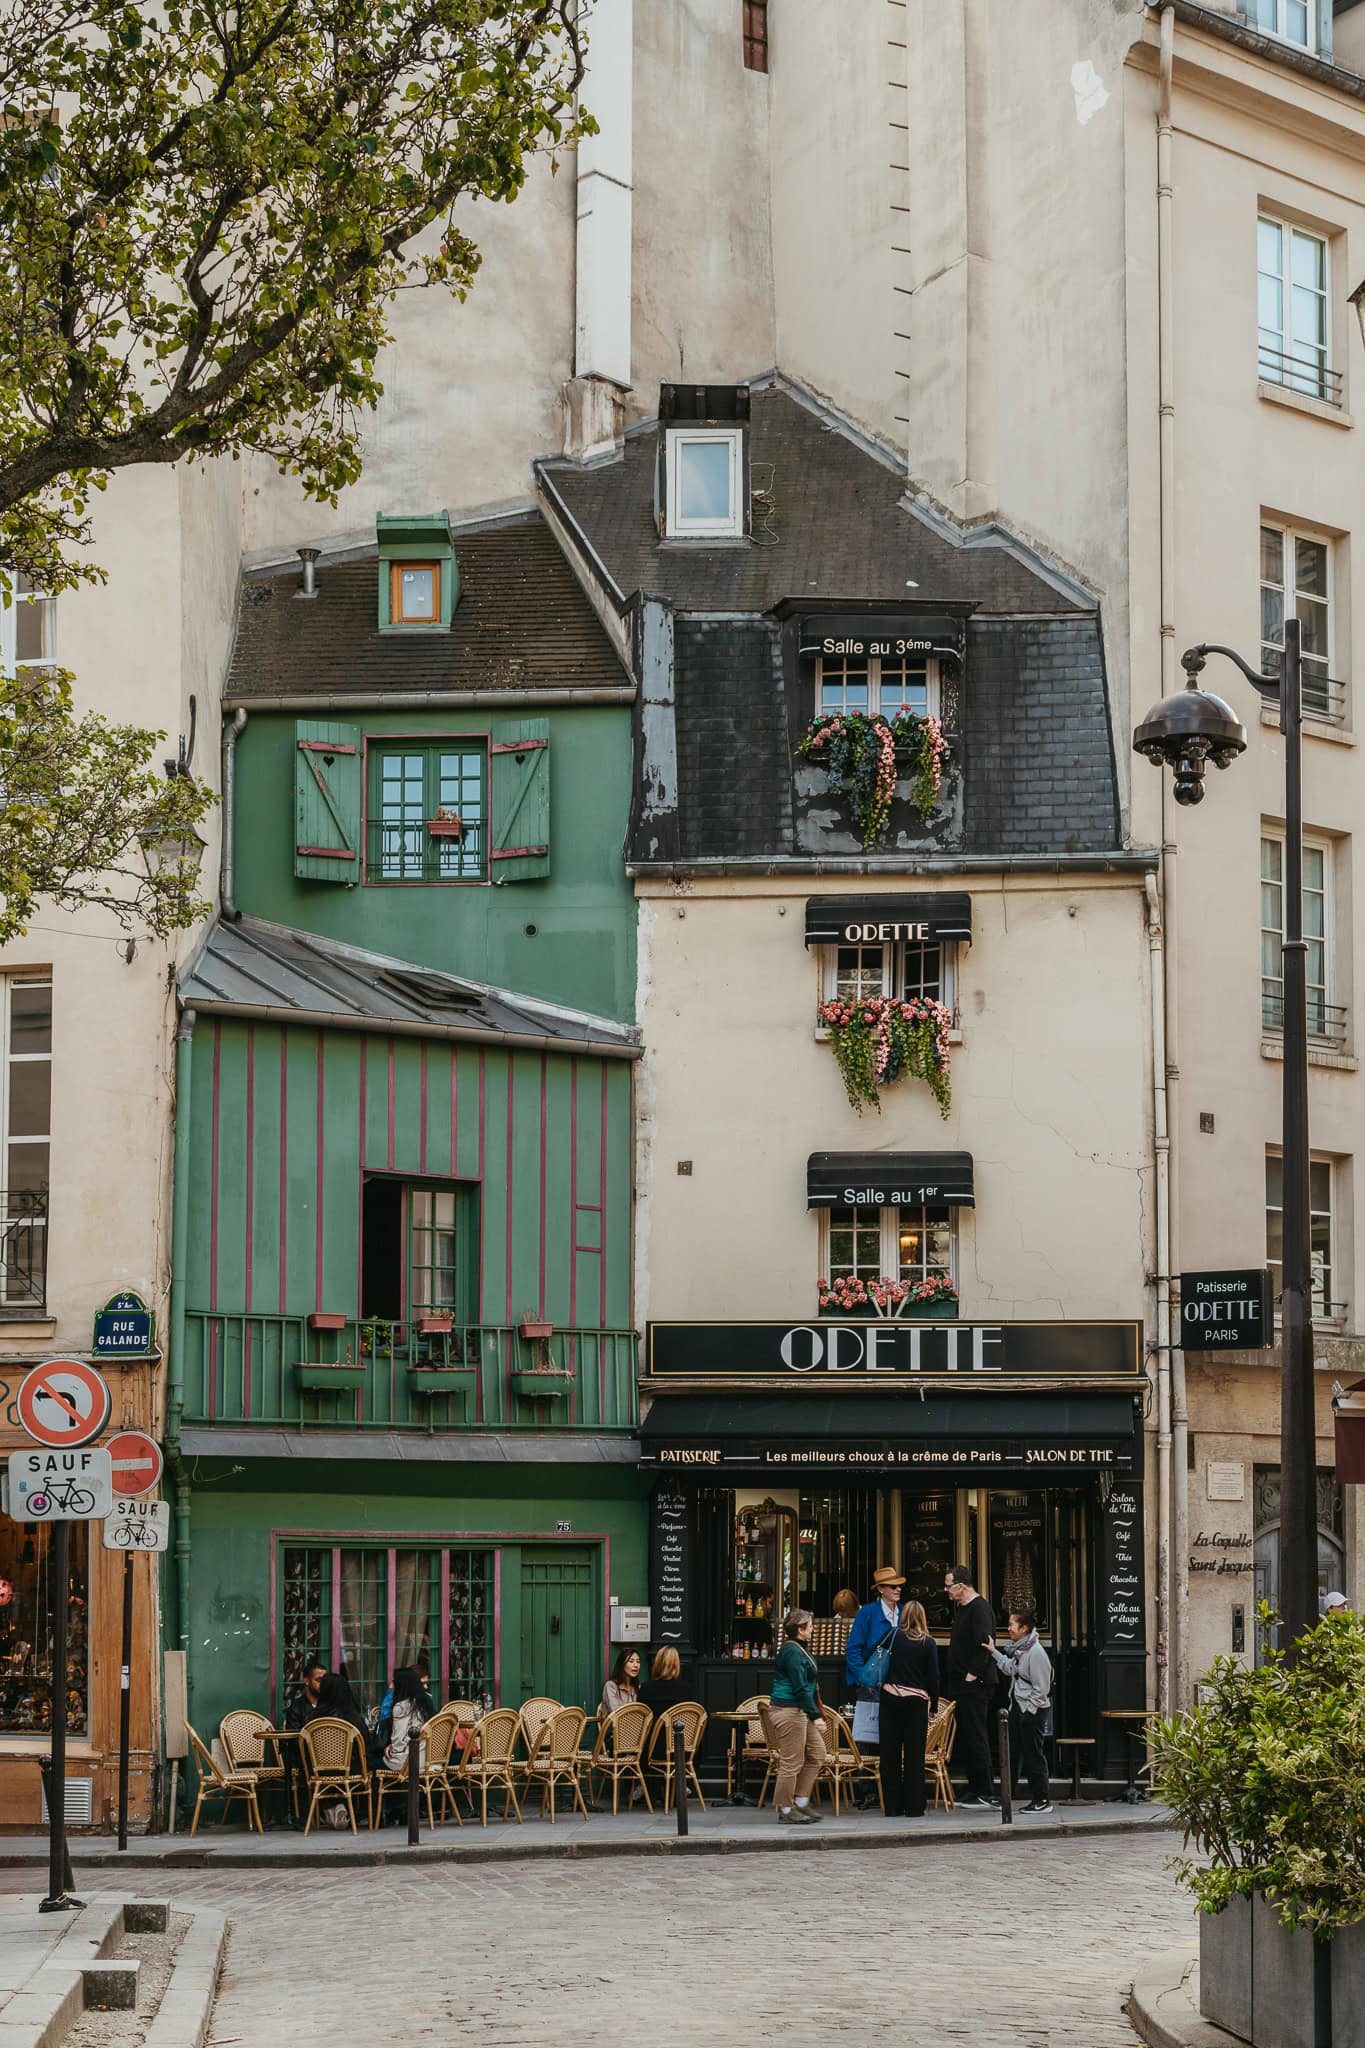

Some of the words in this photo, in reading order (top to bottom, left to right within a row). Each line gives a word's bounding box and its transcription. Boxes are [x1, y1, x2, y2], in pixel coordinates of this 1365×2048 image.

[823, 638, 864, 654] Salle
[870, 642, 890, 655] au
[845, 923, 929, 942] ODETTE
[843, 1188, 885, 1204] Salle
[891, 1191, 911, 1203] au
[917, 1187, 938, 1203] 1er
[1196, 1280, 1247, 1293] Patisserie
[1184, 1300, 1260, 1322] ODETTE
[112, 1321, 136, 1332] RUE
[98, 1335, 148, 1345] GALANDE
[1205, 1329, 1239, 1341] PARIS
[780, 1326, 1002, 1371] ODETTE
[28, 1453, 92, 1472] SAUF
[660, 1449, 722, 1465] PATISSERIE
[766, 1451, 787, 1462] Les
[791, 1451, 845, 1462] meilleurs
[848, 1451, 884, 1462] choux
[887, 1450, 895, 1461] à
[898, 1451, 909, 1461] la
[952, 1451, 967, 1461] de
[970, 1451, 1002, 1461] Paris
[1025, 1449, 1066, 1463] SALON
[1070, 1450, 1087, 1462] DE
[1089, 1450, 1114, 1462] THE
[1110, 1493, 1134, 1503] Salon
[117, 1503, 159, 1516] SAUF
[1109, 1504, 1119, 1513] de
[1119, 1503, 1137, 1513] Thé
[558, 1522, 570, 1531] 75
[1115, 1531, 1131, 1542] Café
[1210, 1532, 1253, 1550] Coquille
[1188, 1557, 1217, 1571] Saint
[1217, 1557, 1257, 1576] Jacques
[1109, 1574, 1138, 1583] Chocolat
[1107, 1602, 1128, 1613] Salle
[1129, 1605, 1140, 1613] au
[1118, 1614, 1139, 1626] étage
